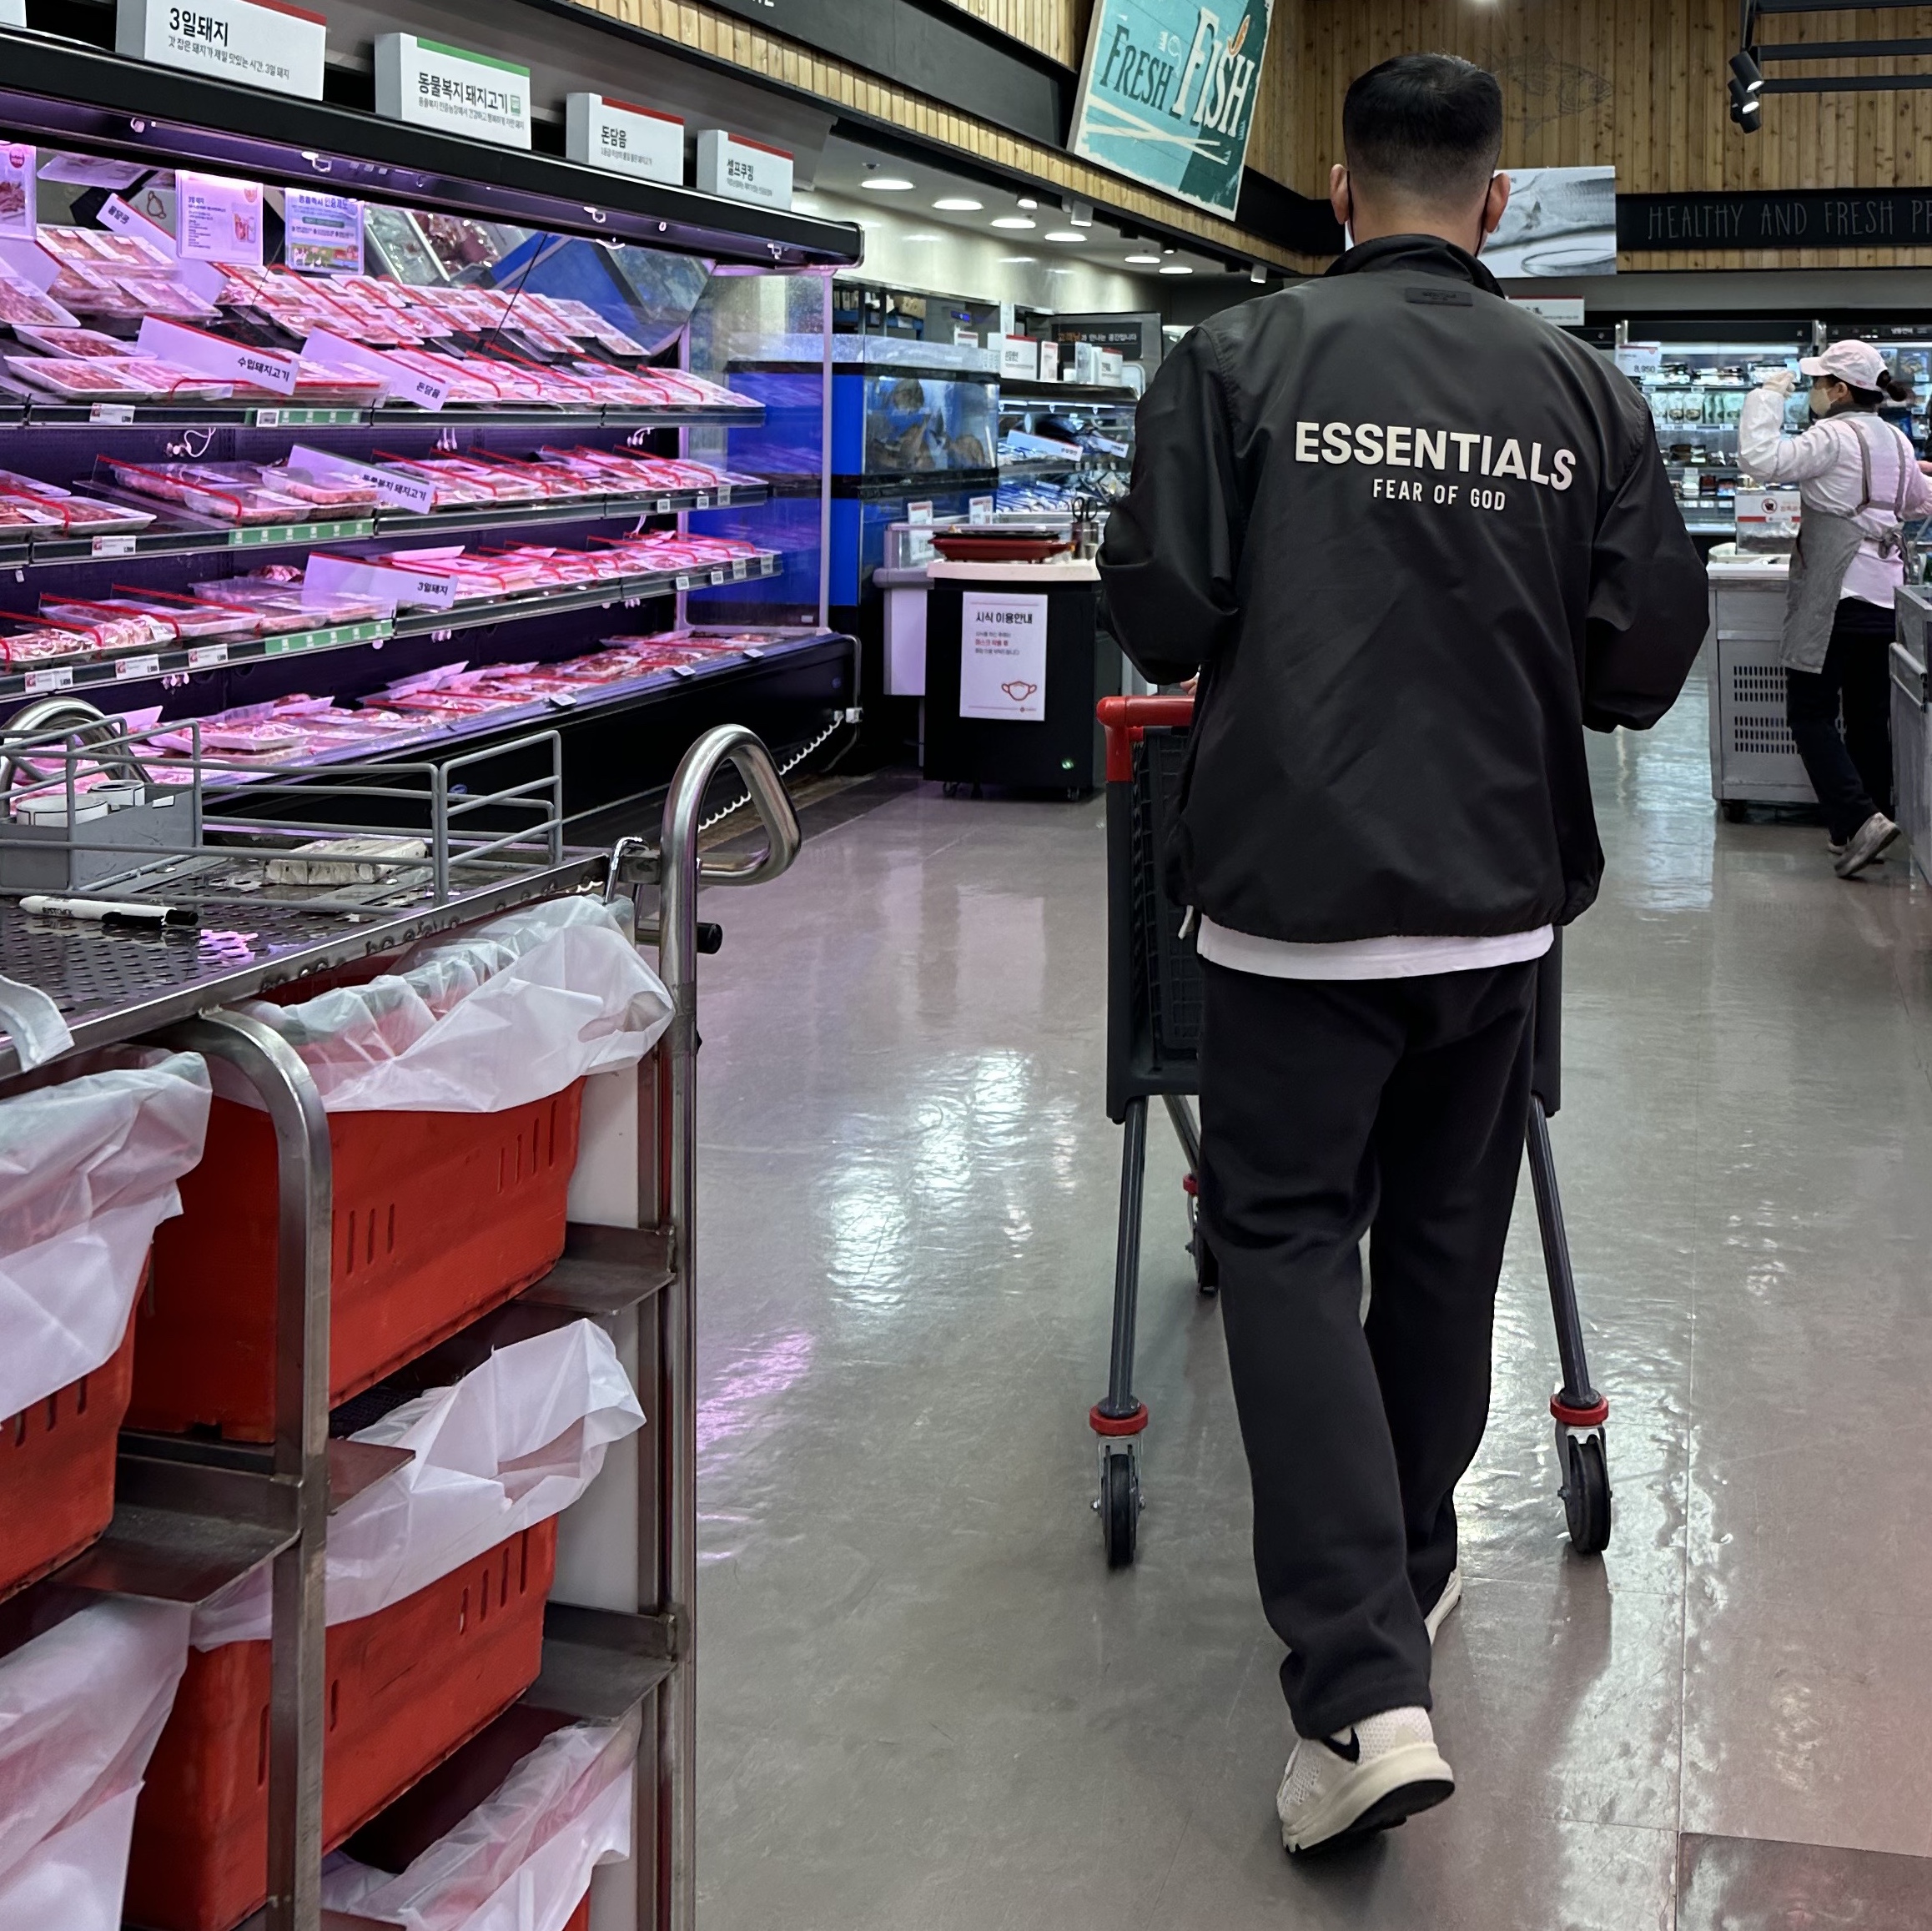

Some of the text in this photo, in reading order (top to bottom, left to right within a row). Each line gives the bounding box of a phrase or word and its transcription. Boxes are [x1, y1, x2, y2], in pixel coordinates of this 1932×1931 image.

[169, 8, 229, 47] 3일돼지
[169, 35, 175, 48] 갓
[177, 38, 191, 53] 잡은
[192, 43, 214, 58] 돼지가
[214, 48, 229, 63] 제일
[229, 53, 249, 69] 맛있는
[276, 68, 290, 80] 돼지
[1099, 7, 1255, 138] FRESH FISH
[418, 72, 508, 114] 동물복지 돼지고기
[601, 125, 626, 148] 돈담음
[727, 158, 754, 182] 셀프쿠킹
[1648, 204, 1743, 240] HEALTHY
[1761, 203, 1807, 235] AND
[1824, 200, 1894, 235] FRESH
[237, 357, 290, 382] 수입돼지고기
[1295, 421, 1577, 491] ESSENTIALS
[394, 484, 426, 501] 돼지고기
[1372, 479, 1506, 511] FEAR OF GOD
[417, 582, 448, 596] 3일돼지
[976, 611, 1033, 625] 시식 이용안내
